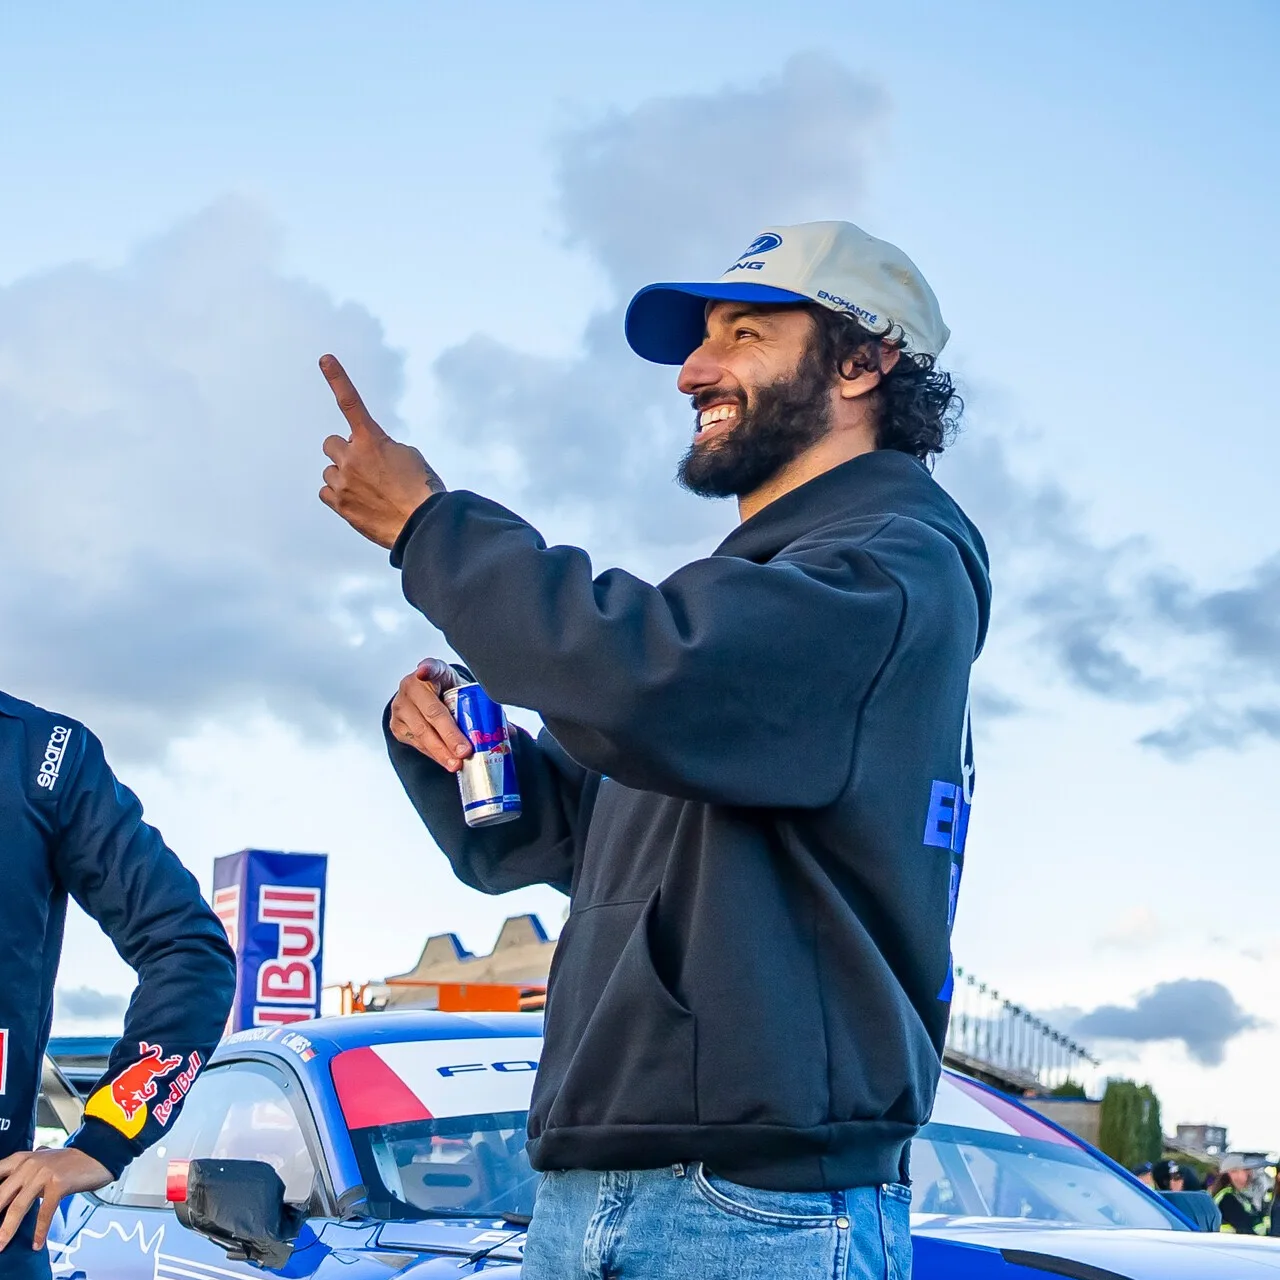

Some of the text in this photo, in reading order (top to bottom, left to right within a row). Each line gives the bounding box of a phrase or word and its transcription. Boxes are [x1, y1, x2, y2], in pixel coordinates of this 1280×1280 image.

[817, 290, 878, 324] ENCHANTÉ
[37, 725, 73, 791] sparco
[152, 1050, 202, 1127] Red Bull
